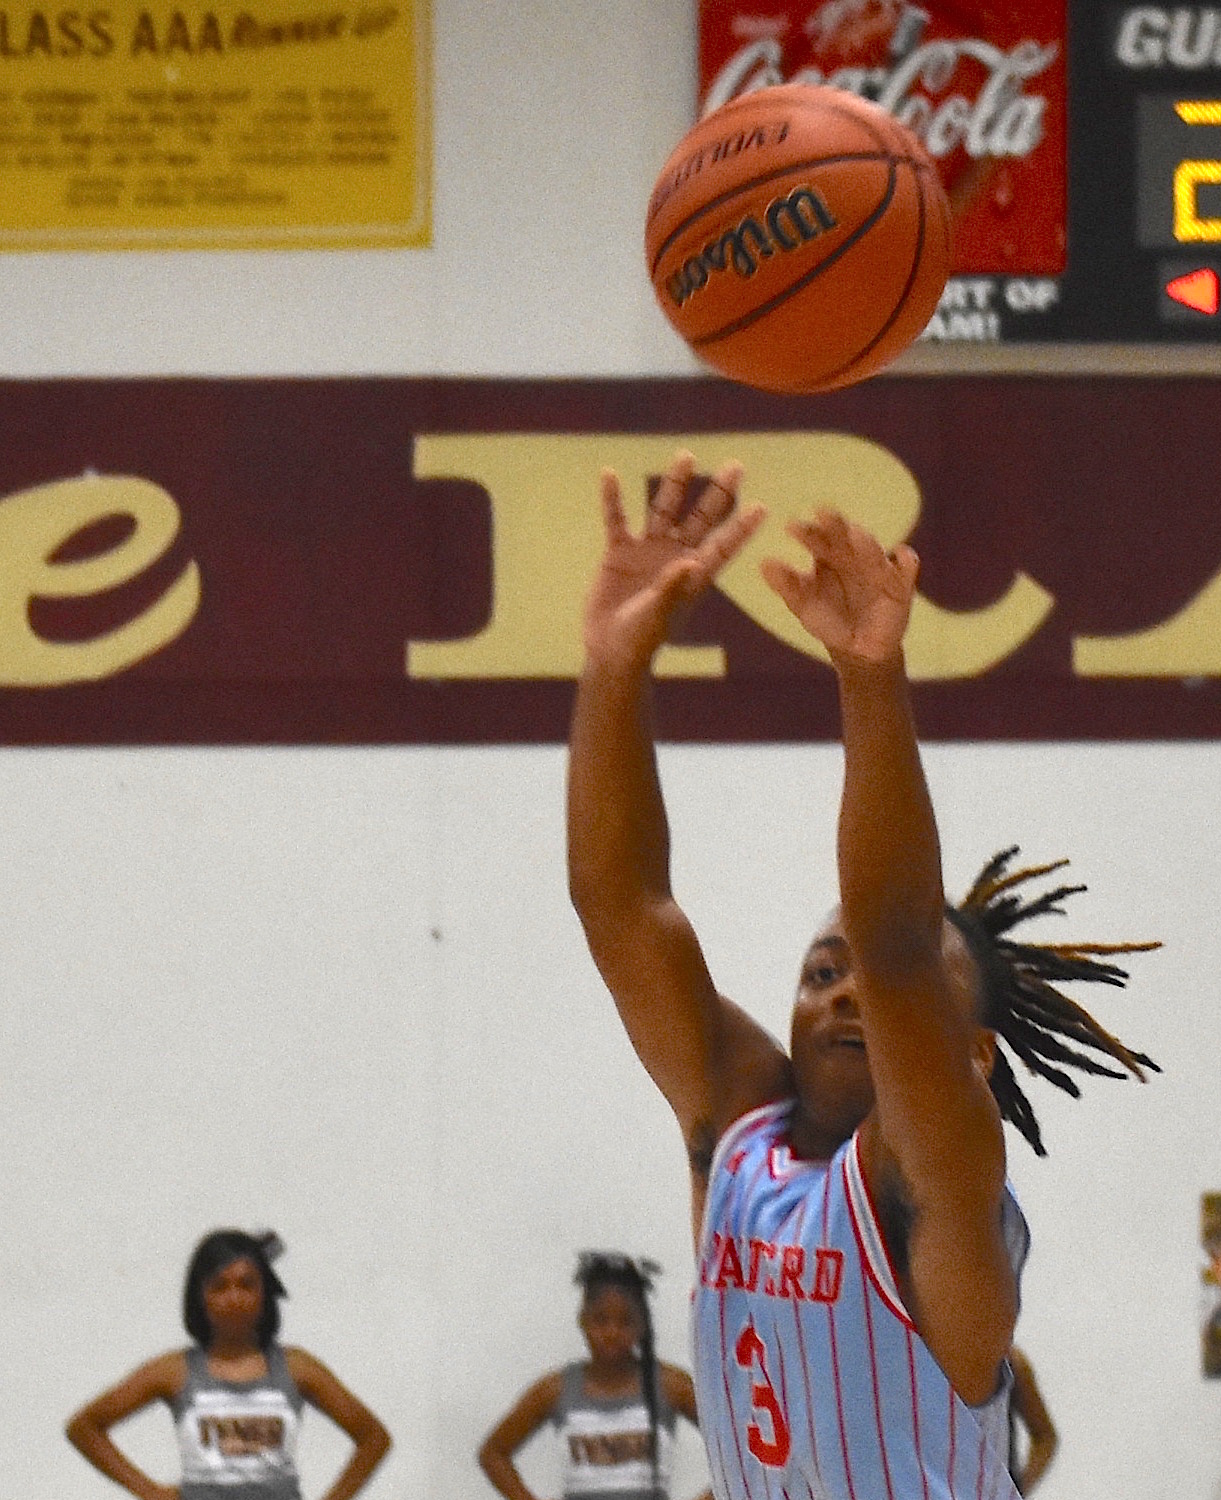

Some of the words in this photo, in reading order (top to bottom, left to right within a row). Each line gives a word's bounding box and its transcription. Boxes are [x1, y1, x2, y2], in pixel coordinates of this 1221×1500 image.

[131, 10, 225, 57] AAA
[665, 184, 838, 307] Wilson
[0, 472, 202, 687] e
[734, 1323, 792, 1469] 3
